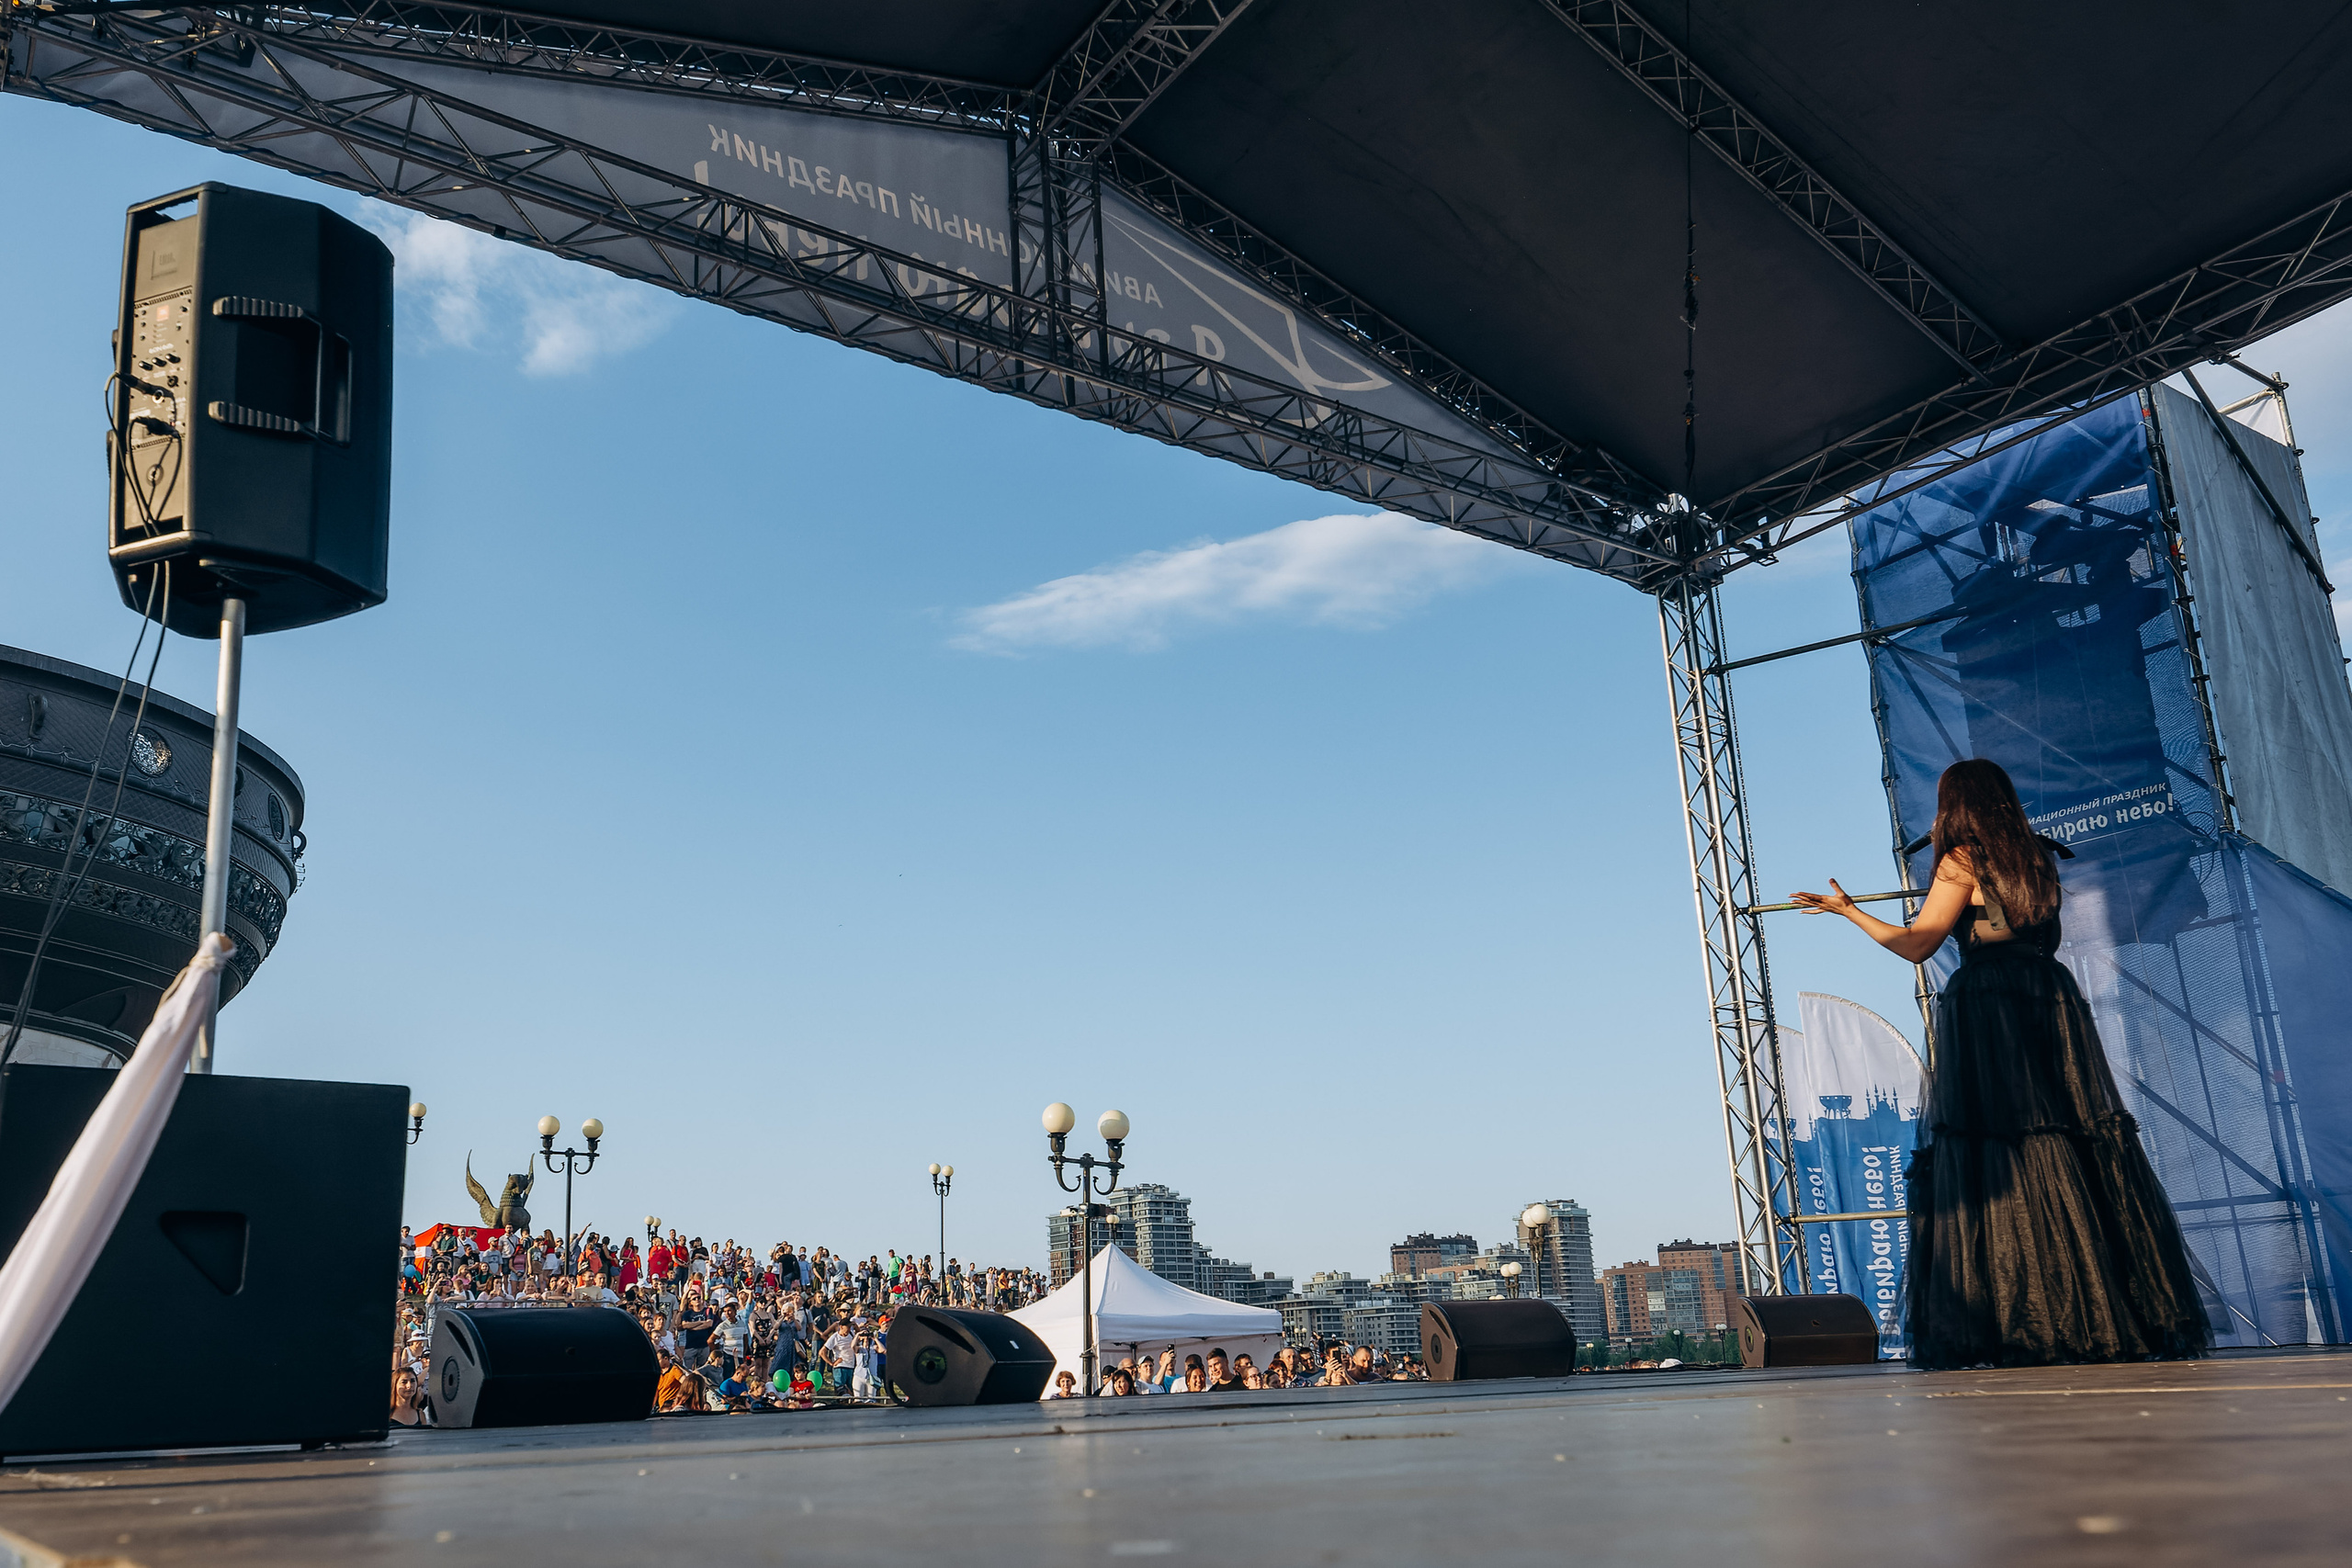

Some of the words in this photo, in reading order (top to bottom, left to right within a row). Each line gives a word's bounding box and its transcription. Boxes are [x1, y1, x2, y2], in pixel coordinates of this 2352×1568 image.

[2028, 797, 2100, 826] ИАЦИОННЫЙ
[2103, 782, 2166, 807] ПРАЗДНИК
[2034, 814, 2108, 841] бираю
[2116, 792, 2174, 824] небо!
